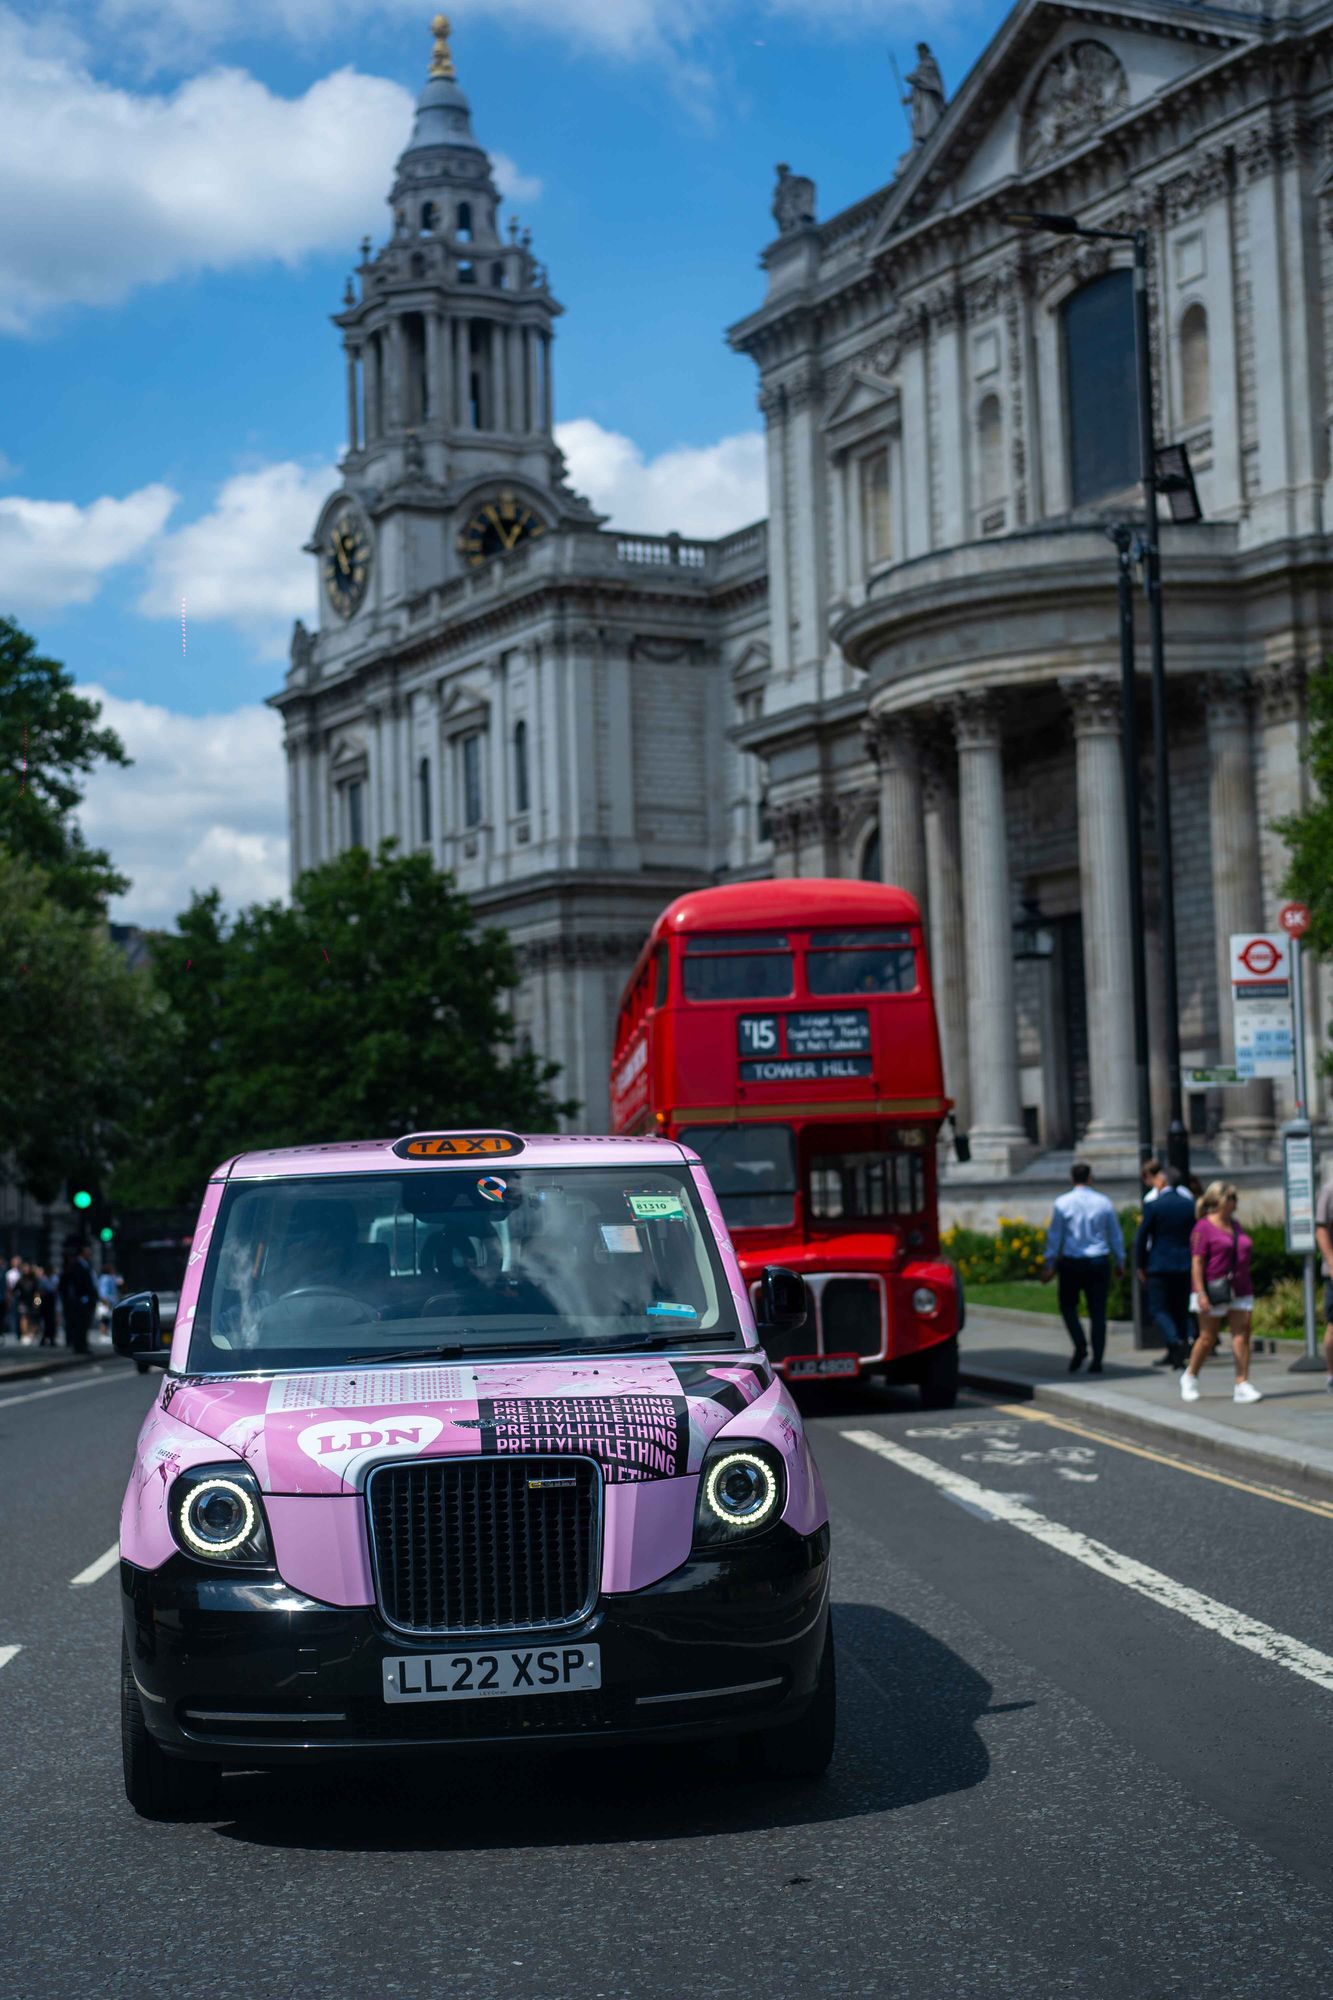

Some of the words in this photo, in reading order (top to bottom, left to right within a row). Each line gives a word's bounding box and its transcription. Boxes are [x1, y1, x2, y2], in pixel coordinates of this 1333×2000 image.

[740, 1019, 776, 1049] T15
[753, 1063, 817, 1080] TOWER
[822, 1060, 859, 1076] HILL
[417, 1139, 502, 1152] TAXI
[636, 1202, 667, 1210] 81310
[493, 1398, 673, 1407] PRETTYLITTLETHING
[493, 1405, 676, 1415] PRETTYLITTLETHING
[317, 1427, 422, 1455] LDN
[495, 1423, 677, 1451] PRETTYLITTLETHING
[496, 1437, 676, 1477] PRETTYLITTLETHING
[398, 1655, 500, 1694] LL22
[511, 1649, 585, 1687] XSP
